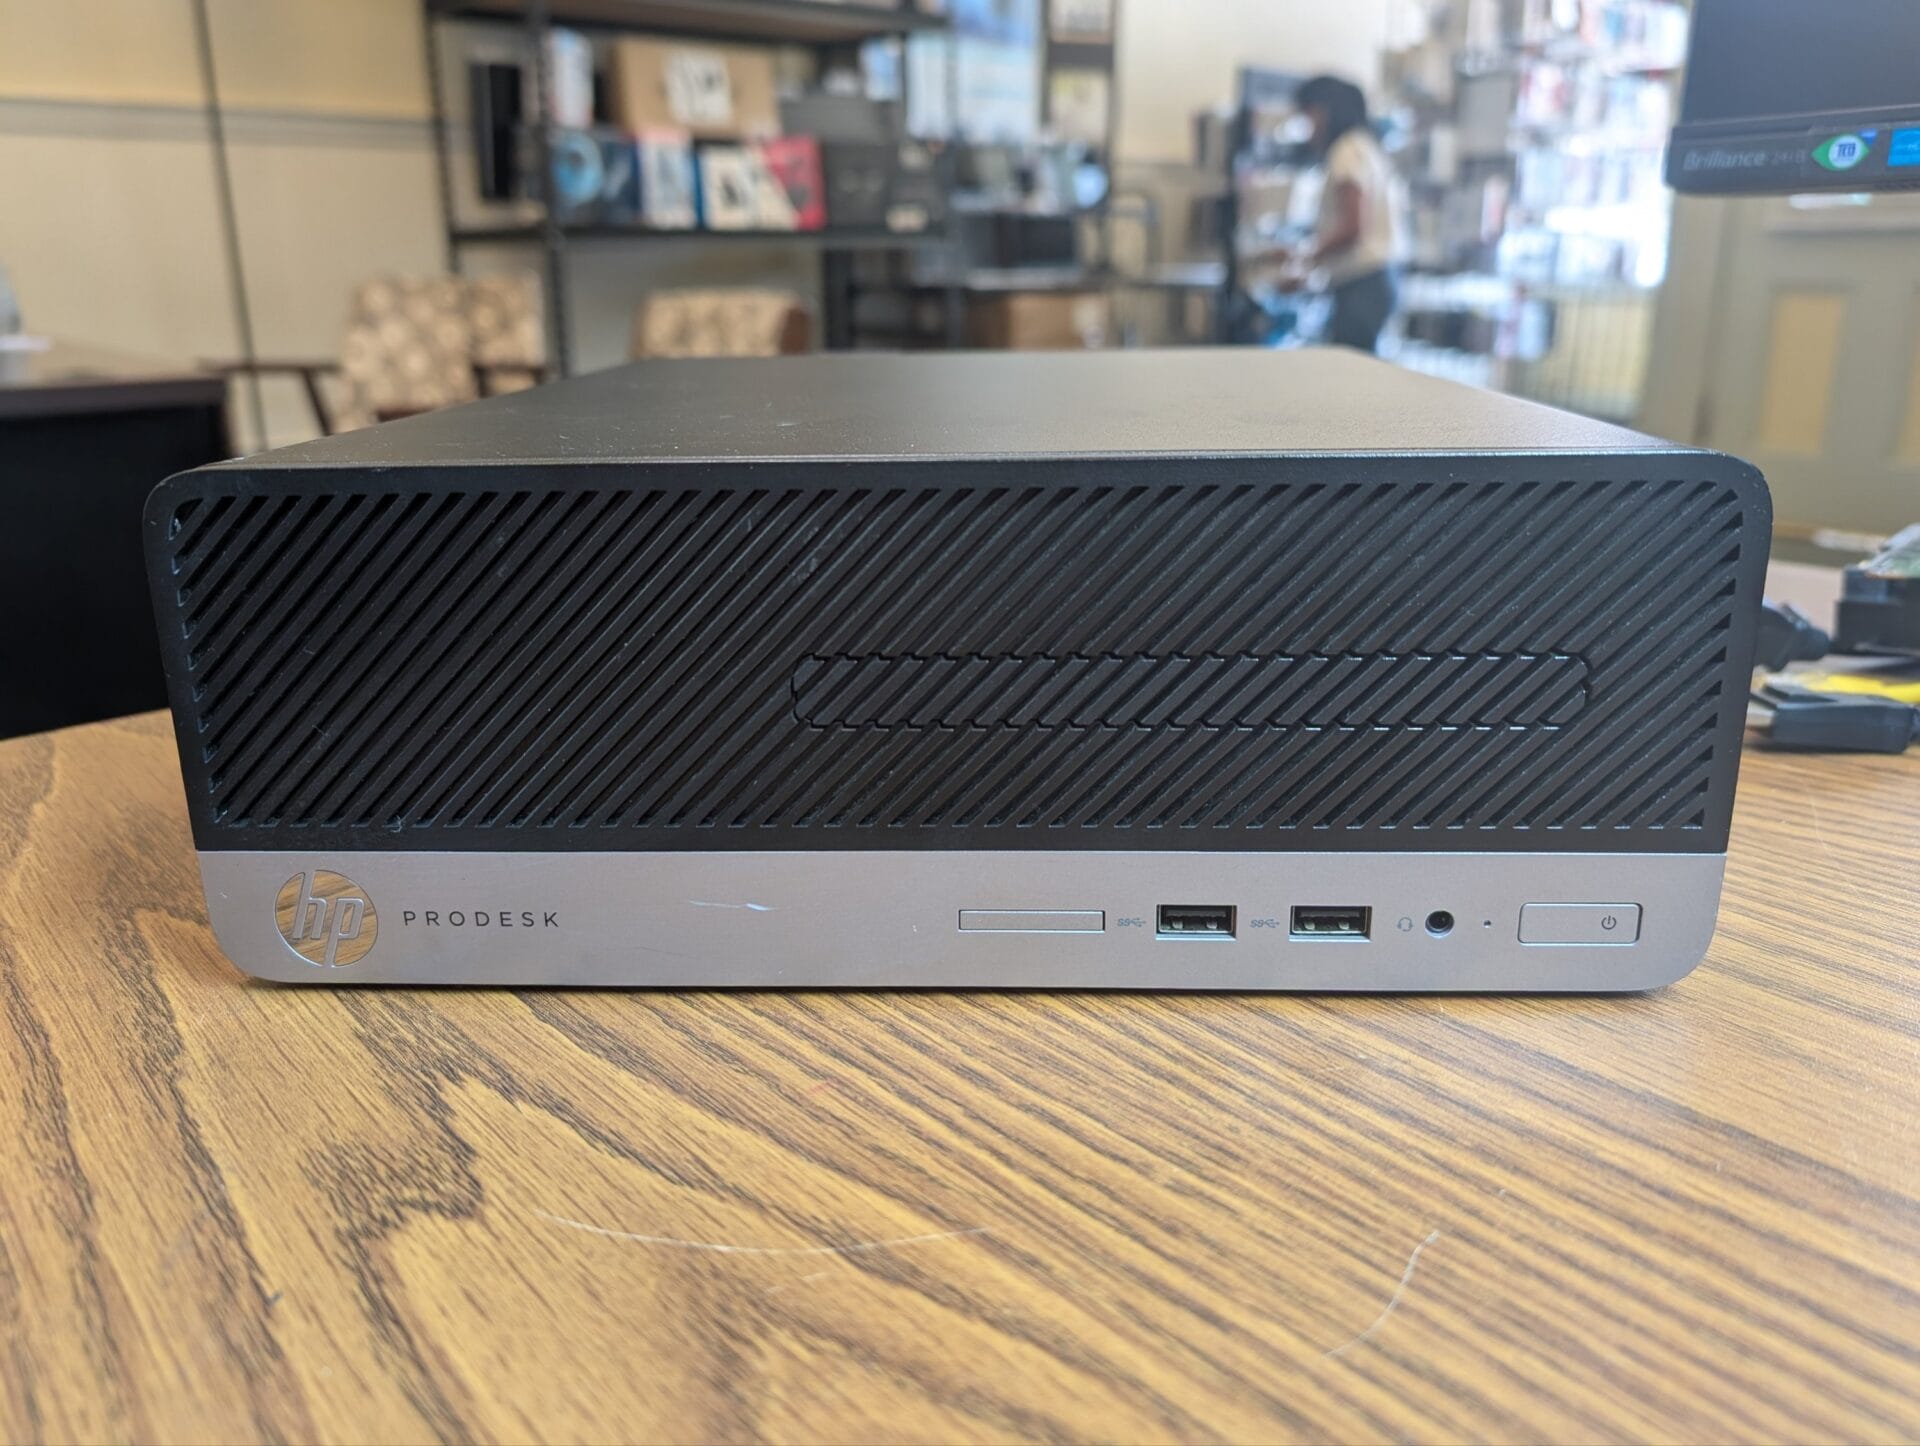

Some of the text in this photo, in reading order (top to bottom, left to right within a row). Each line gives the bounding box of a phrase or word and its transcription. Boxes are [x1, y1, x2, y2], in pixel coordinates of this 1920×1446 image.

[1684, 149, 1765, 171] Brilliance
[291, 869, 366, 968] hp
[403, 910, 559, 928] PRODESK
